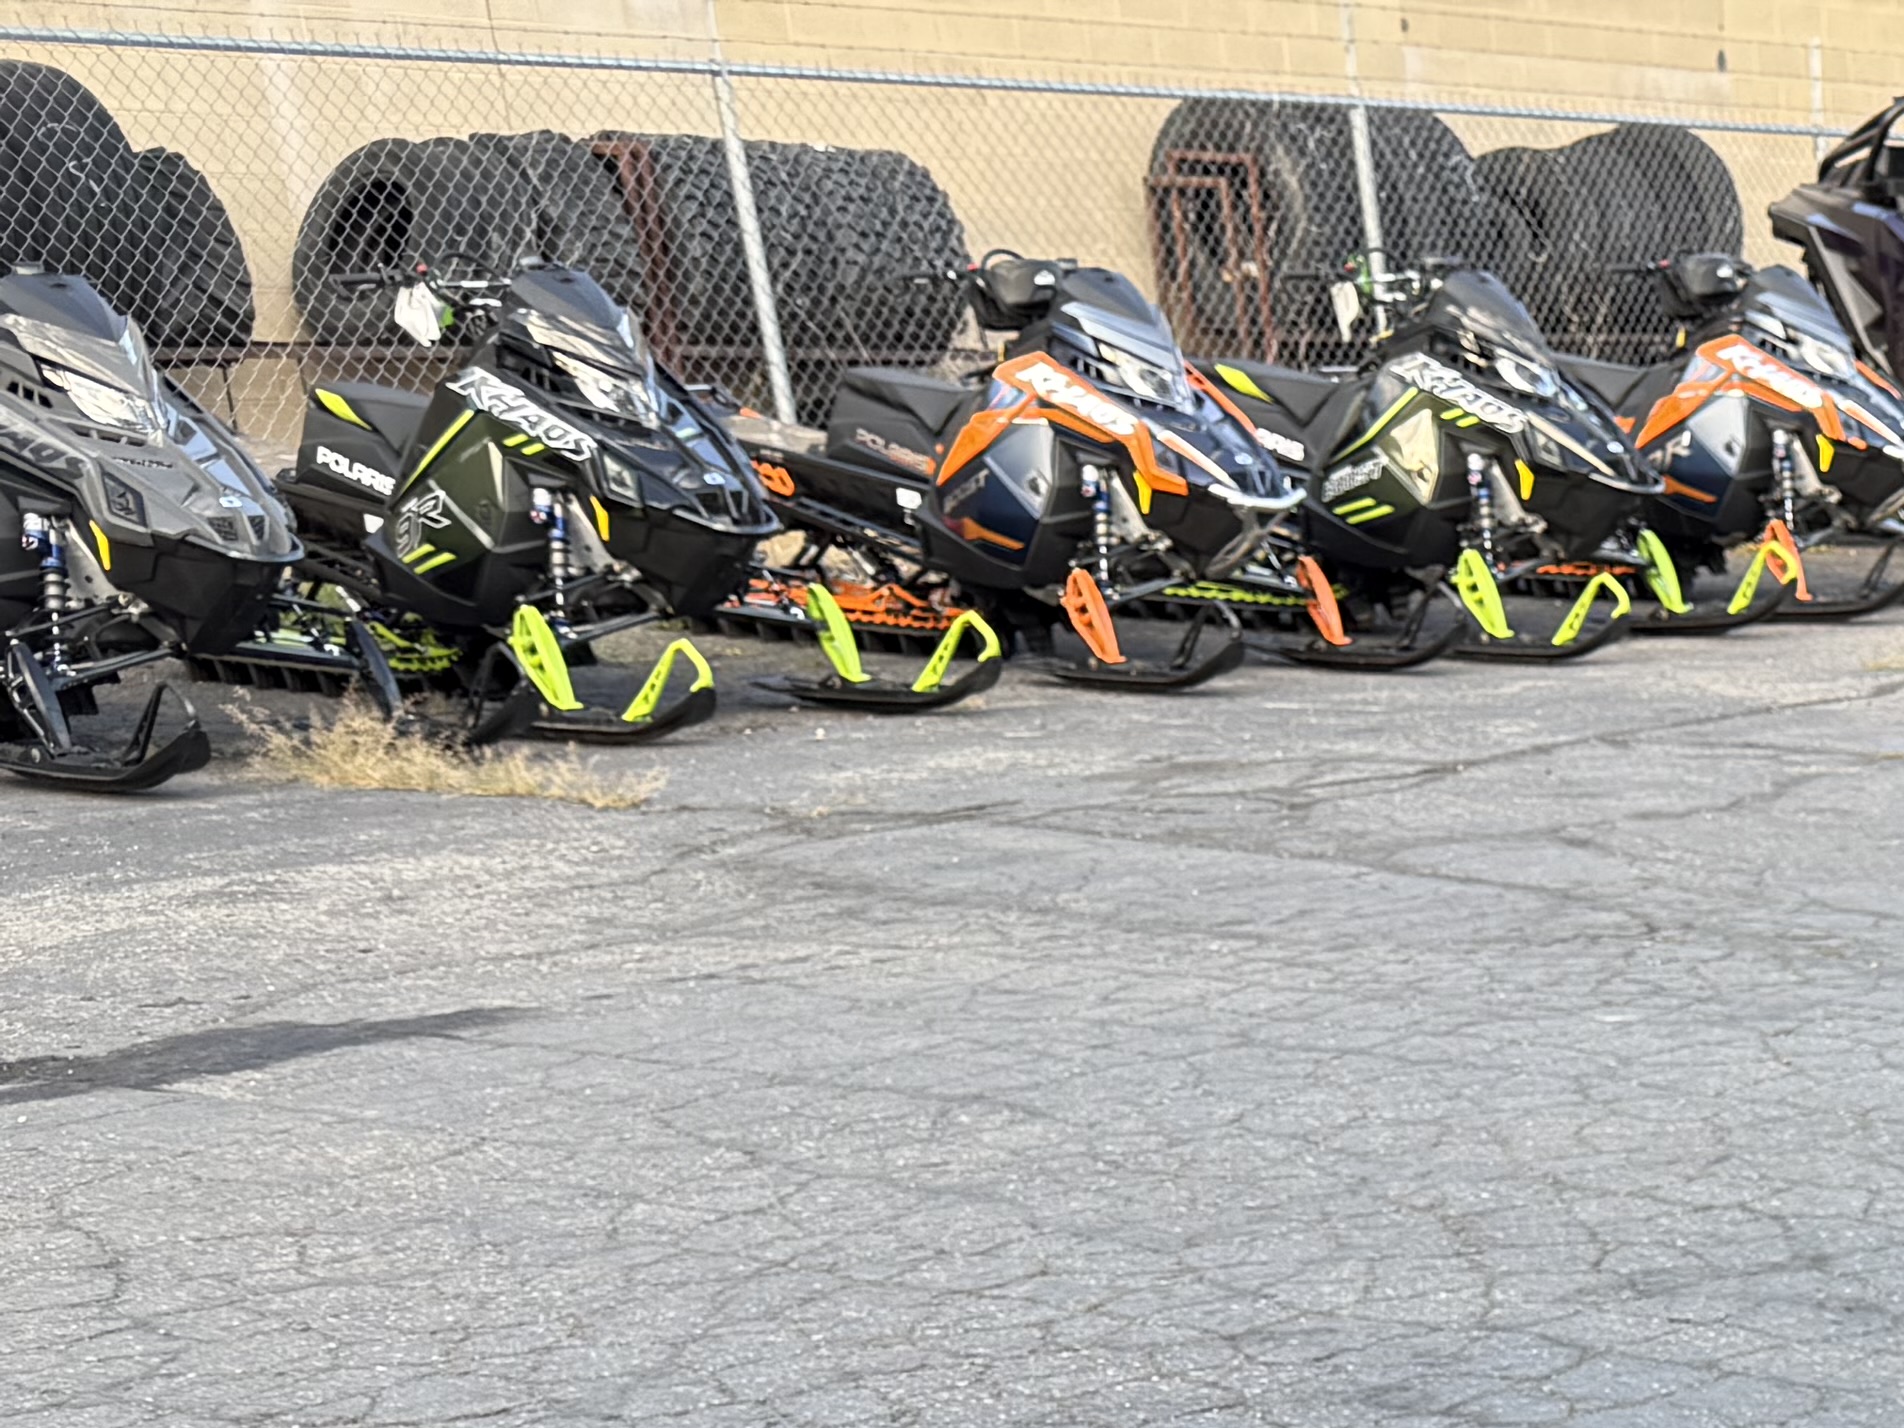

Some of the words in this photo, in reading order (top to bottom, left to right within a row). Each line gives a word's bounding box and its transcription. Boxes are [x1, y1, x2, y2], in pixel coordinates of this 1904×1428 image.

[446, 366, 597, 461] KHAOS
[1016, 362, 1137, 436] KHAOS
[1389, 352, 1526, 433] KHAOS
[1716, 344, 1823, 409] KHAOS
[316, 446, 396, 495] POLARIS
